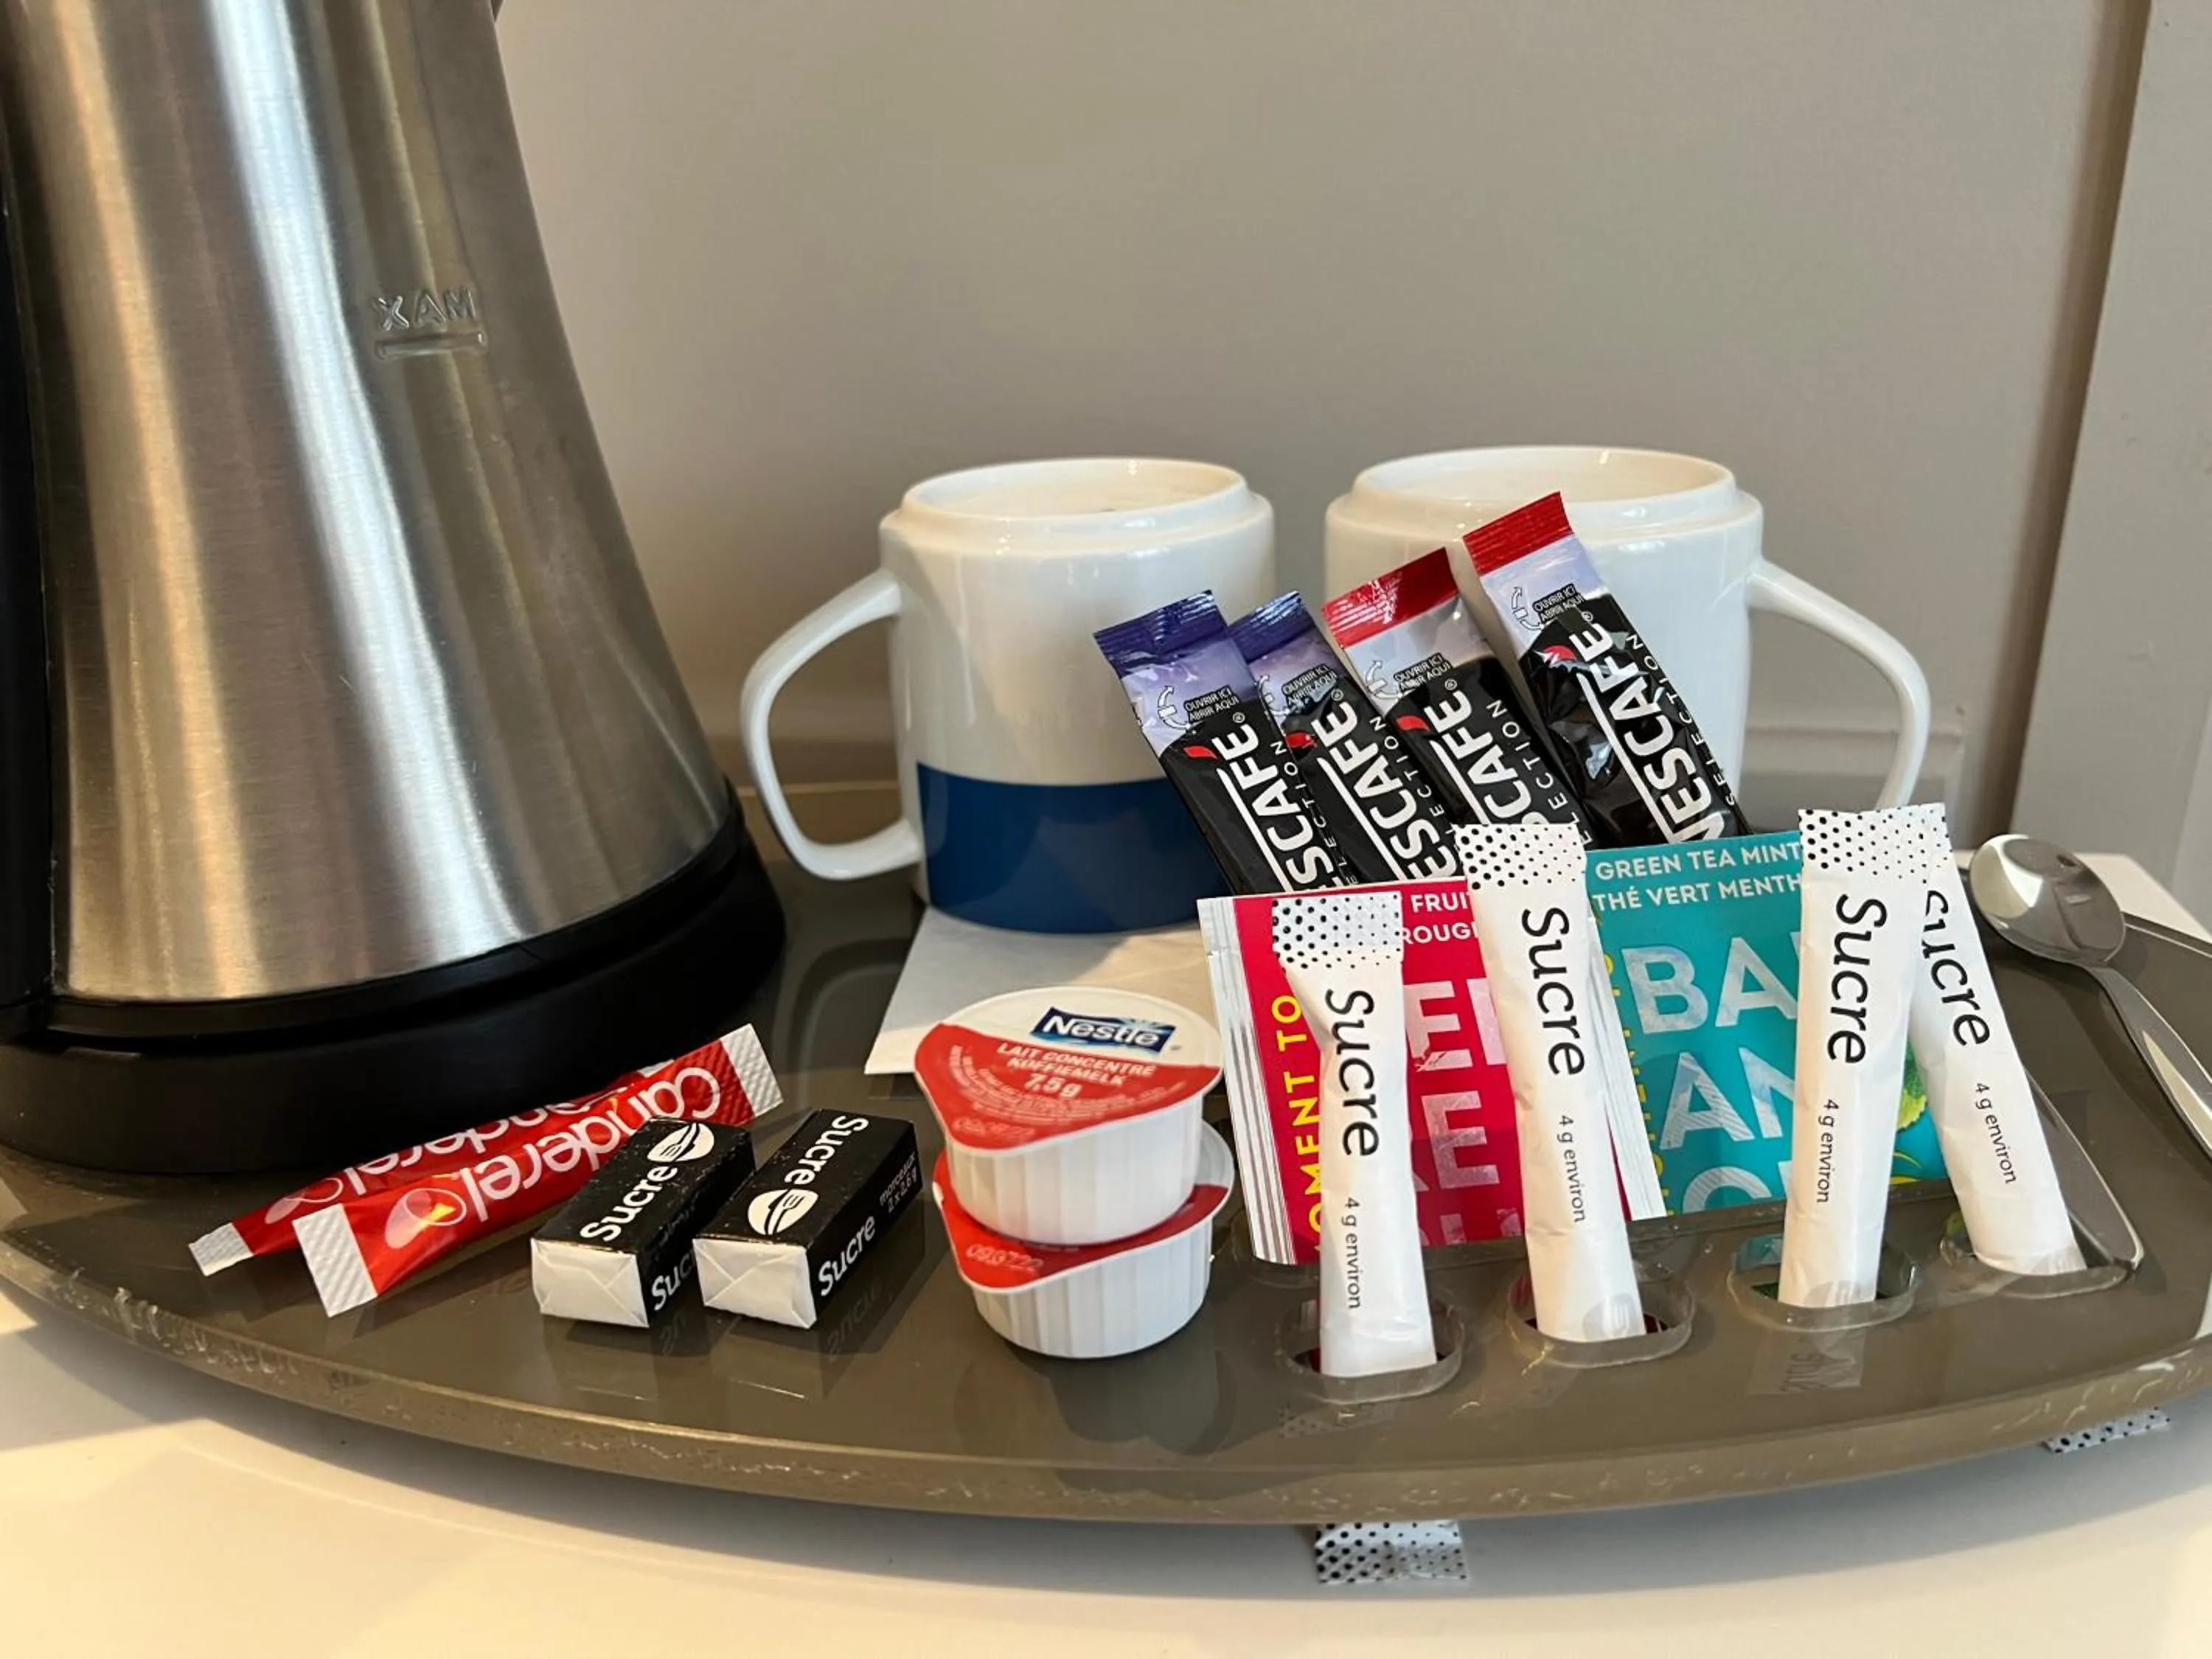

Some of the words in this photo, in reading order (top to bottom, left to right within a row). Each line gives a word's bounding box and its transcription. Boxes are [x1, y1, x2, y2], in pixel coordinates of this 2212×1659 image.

[1486, 700, 1593, 846] ELECTION
[1595, 853, 1682, 881] GREEN
[1686, 849, 1737, 871] TEA
[1740, 841, 1802, 866] MINT
[1410, 891, 1471, 913] FRUI
[1591, 886, 1643, 912] THÉ
[1645, 883, 1711, 907] VERT
[1717, 873, 1801, 900] MENTH
[1522, 907, 1585, 1077] Sucre
[1621, 931, 1801, 1034] BA
[1827, 894, 1887, 1064] Sucre
[1921, 889, 1991, 1046] Sucre
[997, 1042, 1042, 1060] LAIT
[1271, 995, 1307, 1051] TO
[1325, 988, 1380, 1156] Sucre
[1975, 1082, 1990, 1093] 4
[1559, 1114, 1574, 1126] 4
[1818, 1115, 1834, 1127] g
[1823, 1099, 1840, 1110] 4
[1975, 1097, 1992, 1110] g
[784, 1115, 869, 1186] Sucre
[1557, 1131, 1573, 1144] g
[1816, 1134, 1834, 1203] environ
[1984, 1113, 2017, 1185] environ
[580, 1165, 678, 1242] Sucre
[1345, 1197, 1360, 1208] 4
[1563, 1149, 1587, 1223] environ
[1340, 1214, 1357, 1228] g
[651, 1249, 694, 1311] Suc
[818, 1215, 876, 1297] Sucre
[1344, 1232, 1364, 1310] environ
